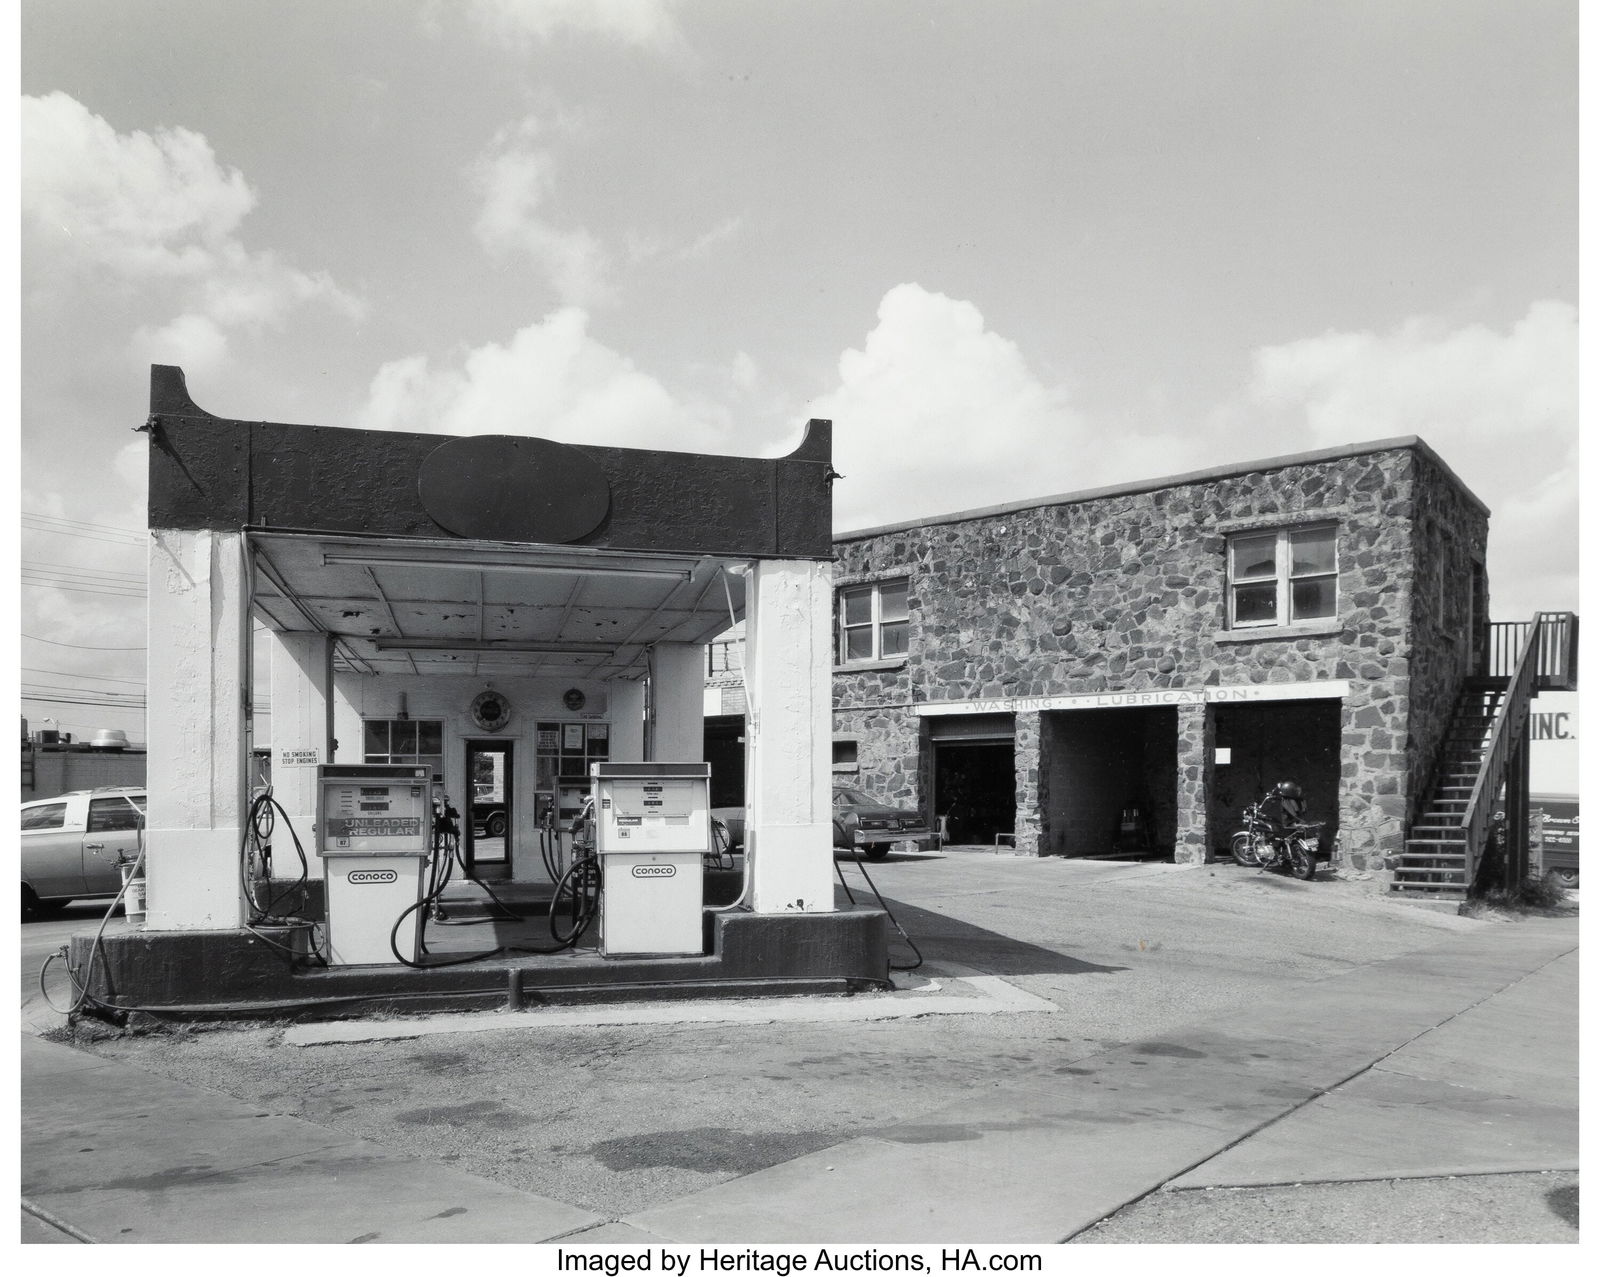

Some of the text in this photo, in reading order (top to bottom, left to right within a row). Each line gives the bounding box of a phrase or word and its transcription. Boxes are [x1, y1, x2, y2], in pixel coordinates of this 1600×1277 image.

[972, 689, 1248, 711] WASHING LUBRICATION
[1532, 712, 1575, 740] INC.
[345, 818, 419, 828] UNLEADED
[348, 827, 416, 836] REGULAR
